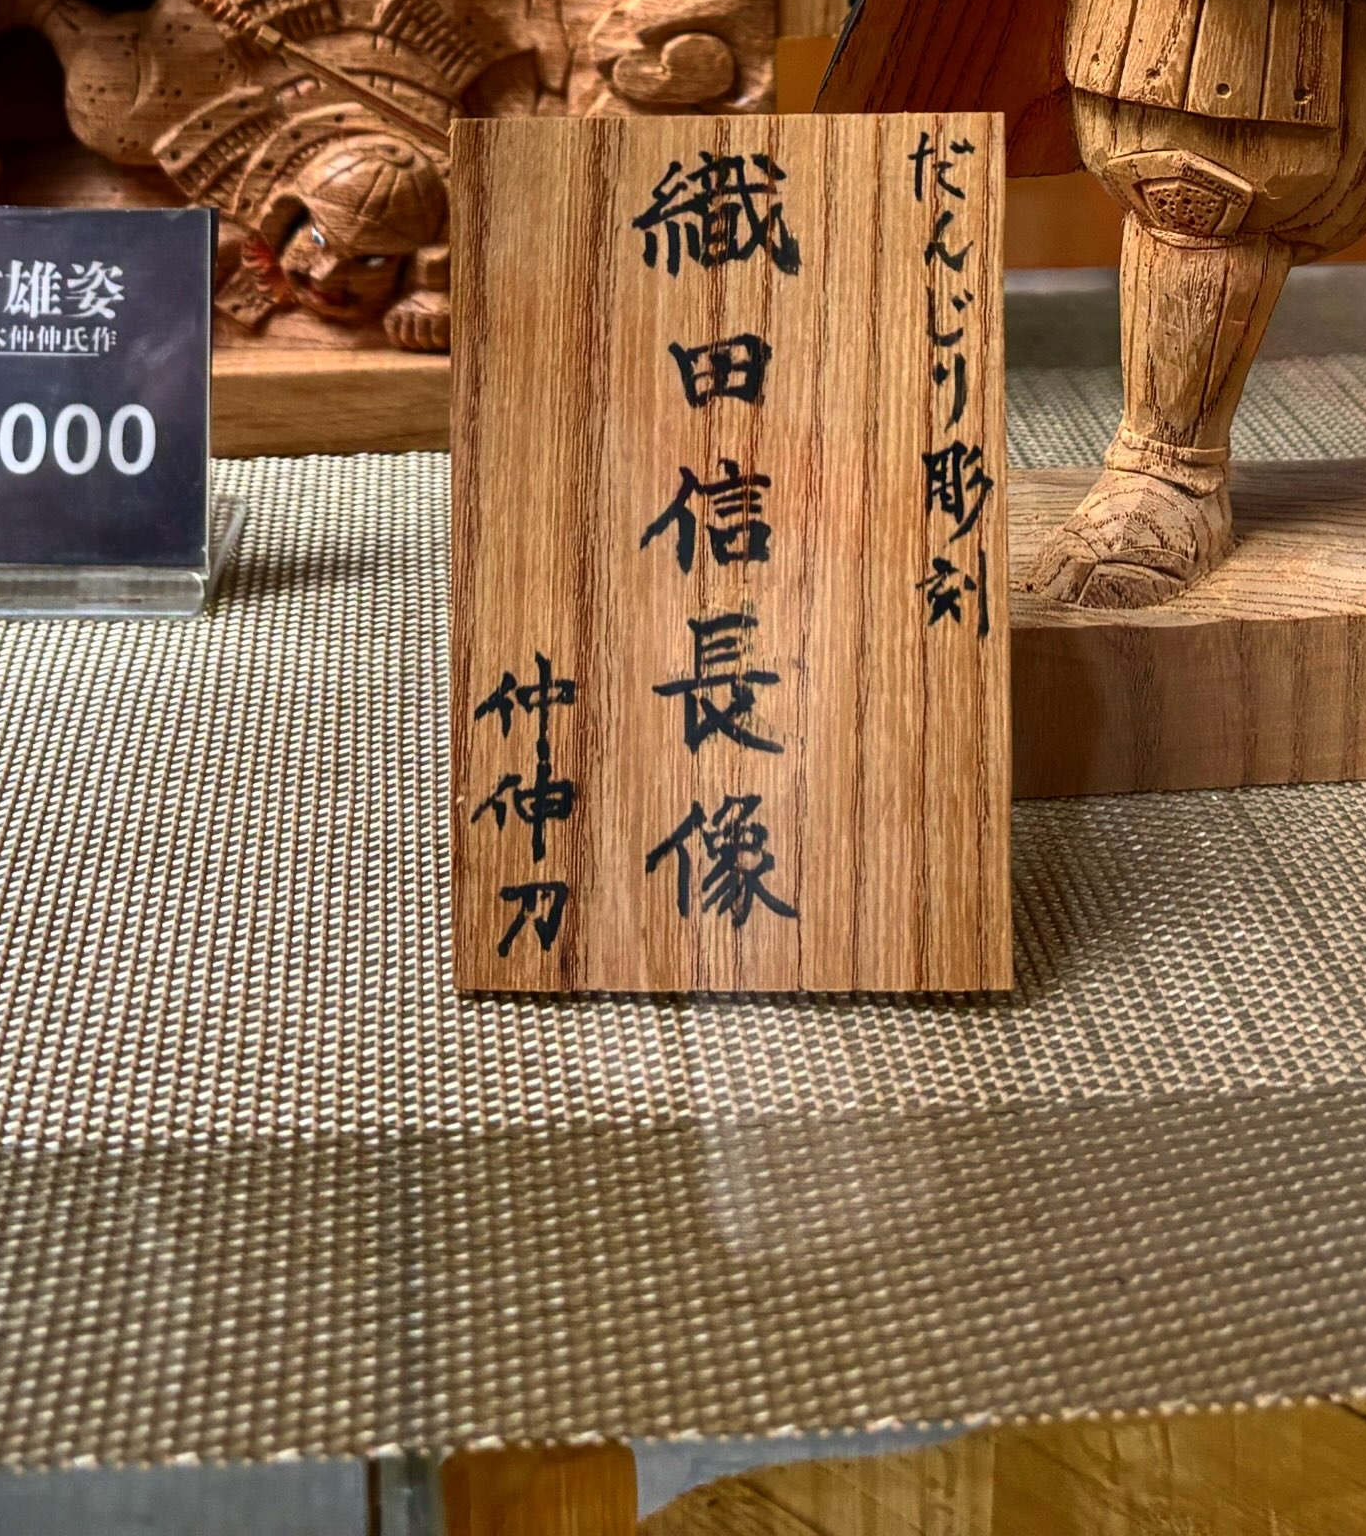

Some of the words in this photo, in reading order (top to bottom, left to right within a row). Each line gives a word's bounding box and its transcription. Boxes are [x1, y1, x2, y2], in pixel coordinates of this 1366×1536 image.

[631, 151, 802, 930] 織田信長像
[907, 131, 996, 638] だんじり彫刻
